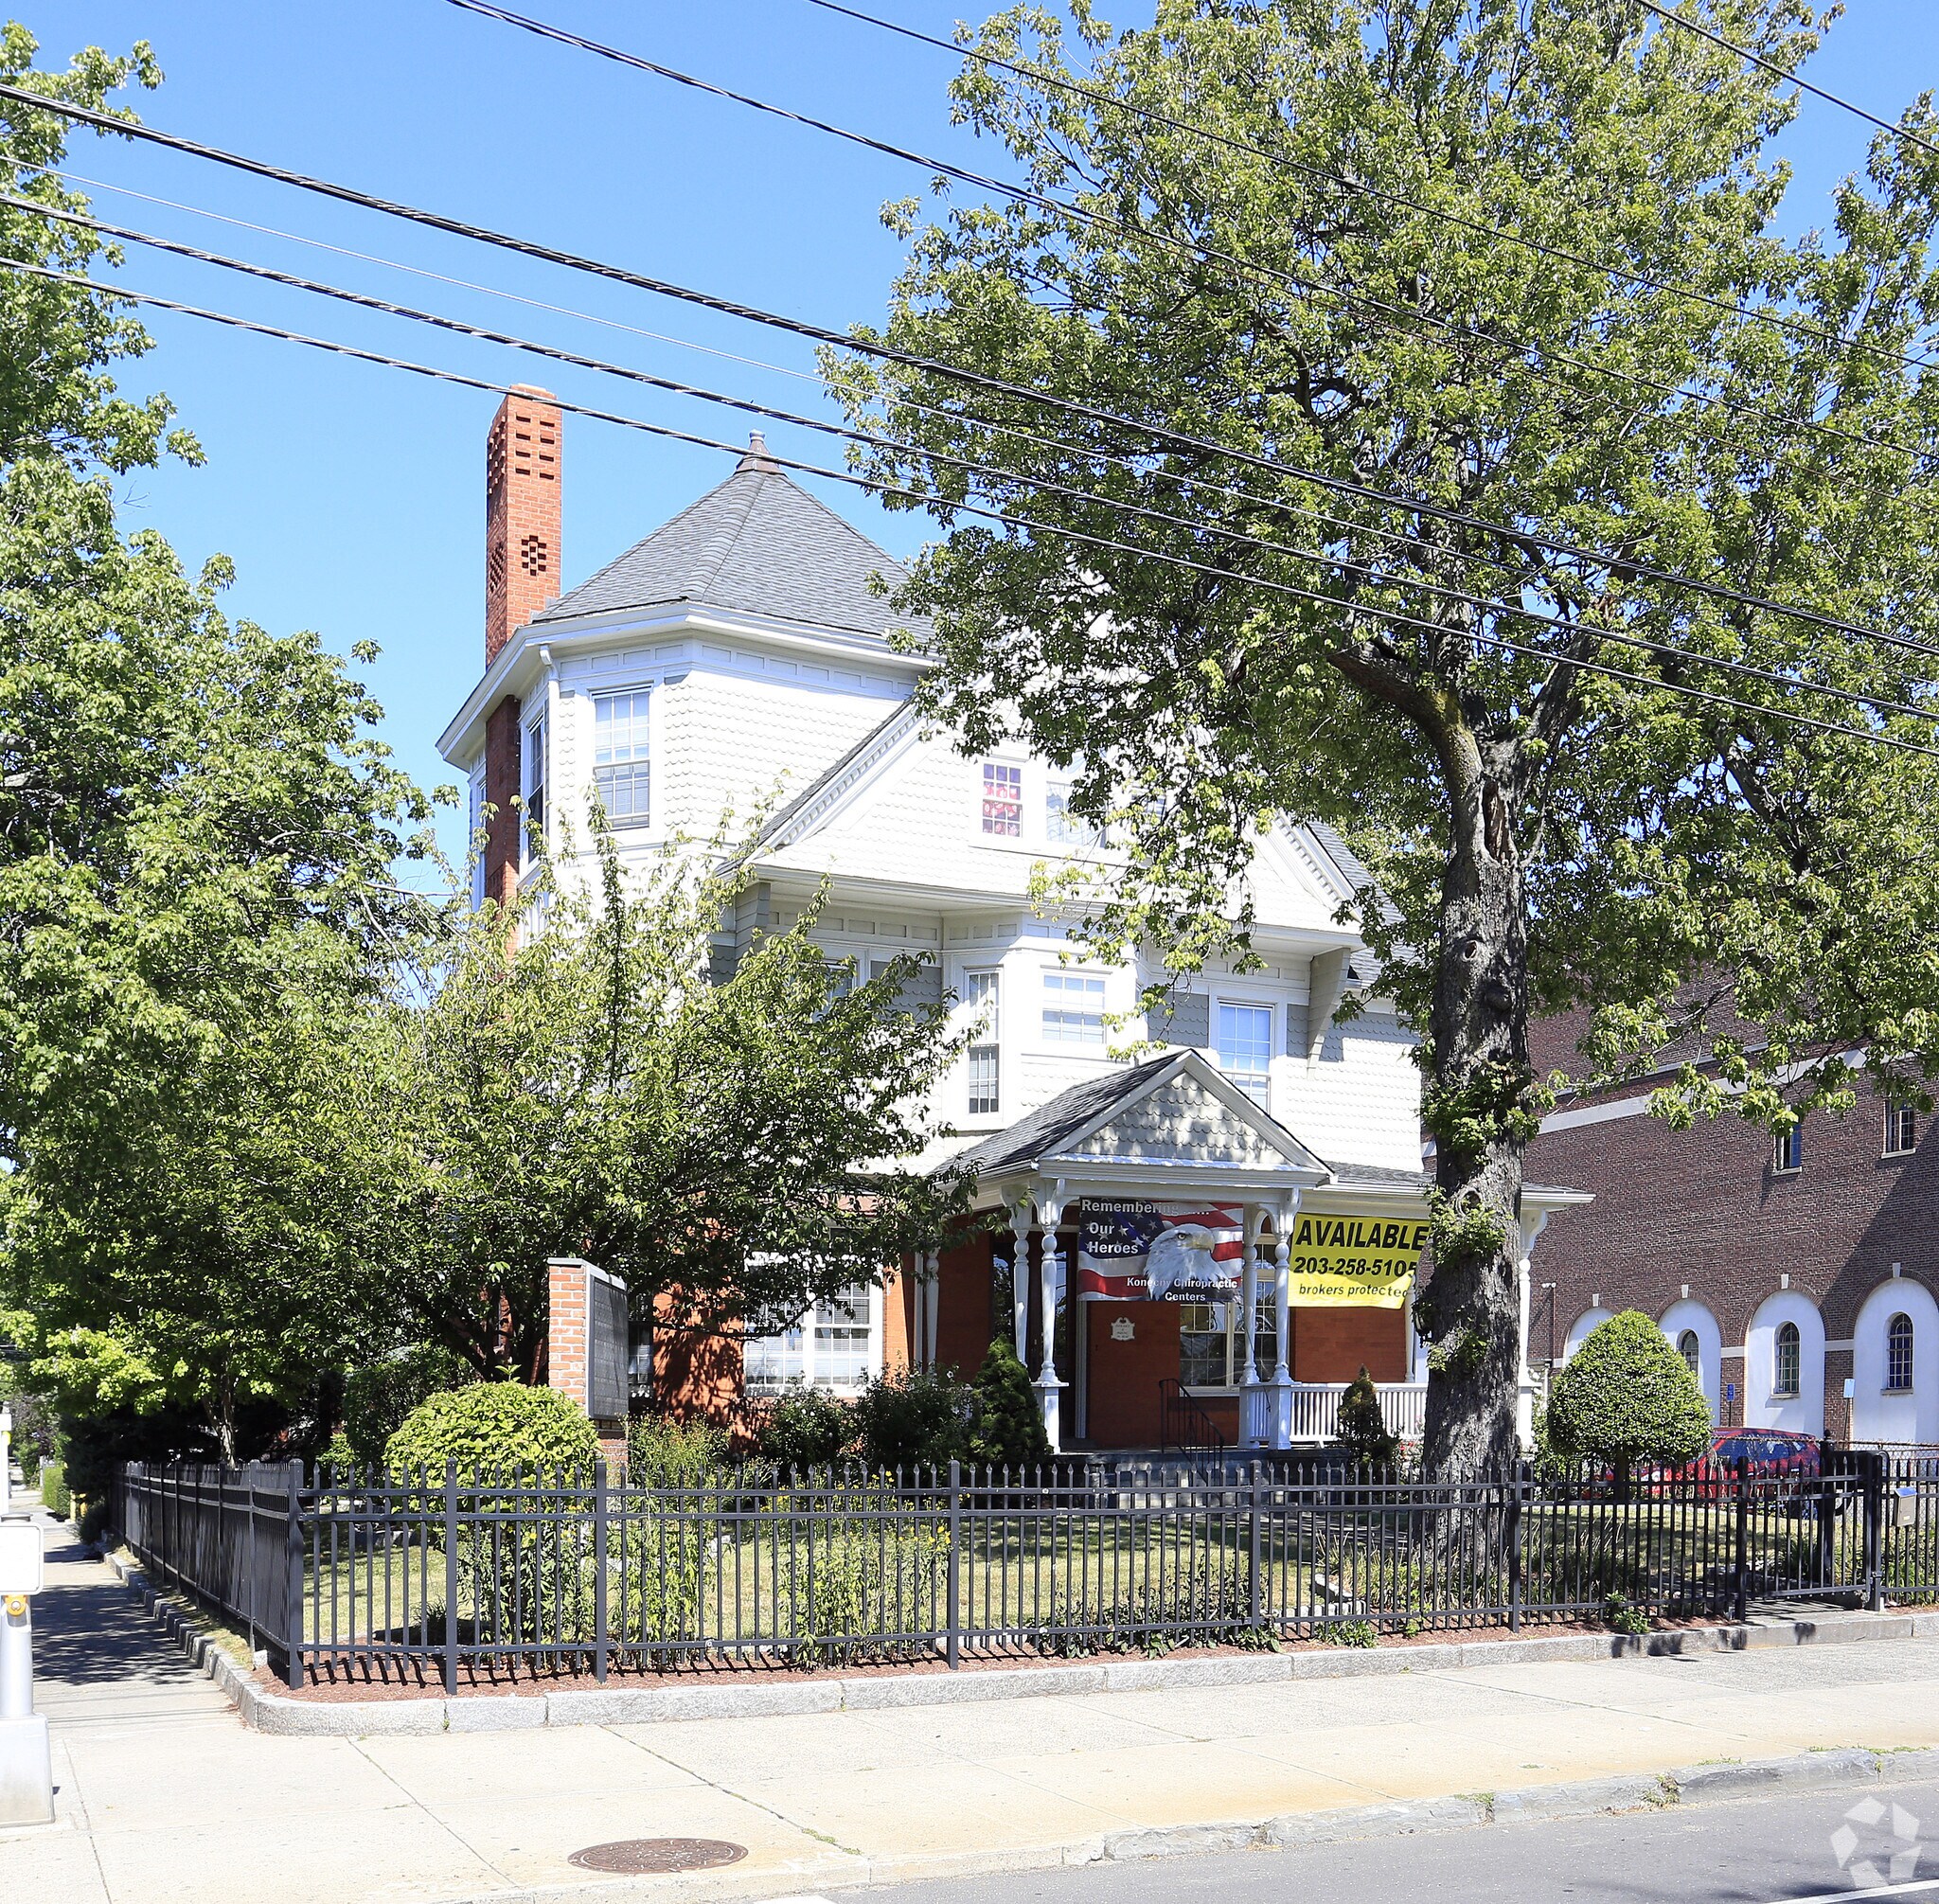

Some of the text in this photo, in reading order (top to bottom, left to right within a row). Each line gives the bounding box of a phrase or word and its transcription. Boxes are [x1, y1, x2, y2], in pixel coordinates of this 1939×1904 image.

[1089, 1222, 1115, 1235] Our
[1295, 1219, 1430, 1251] AVAILABLE
[1088, 1241, 1139, 1254] Heroes
[1173, 1278, 1238, 1290] Chiropractic
[1299, 1284, 1344, 1295] brokers
[1165, 1291, 1206, 1302] Centers
